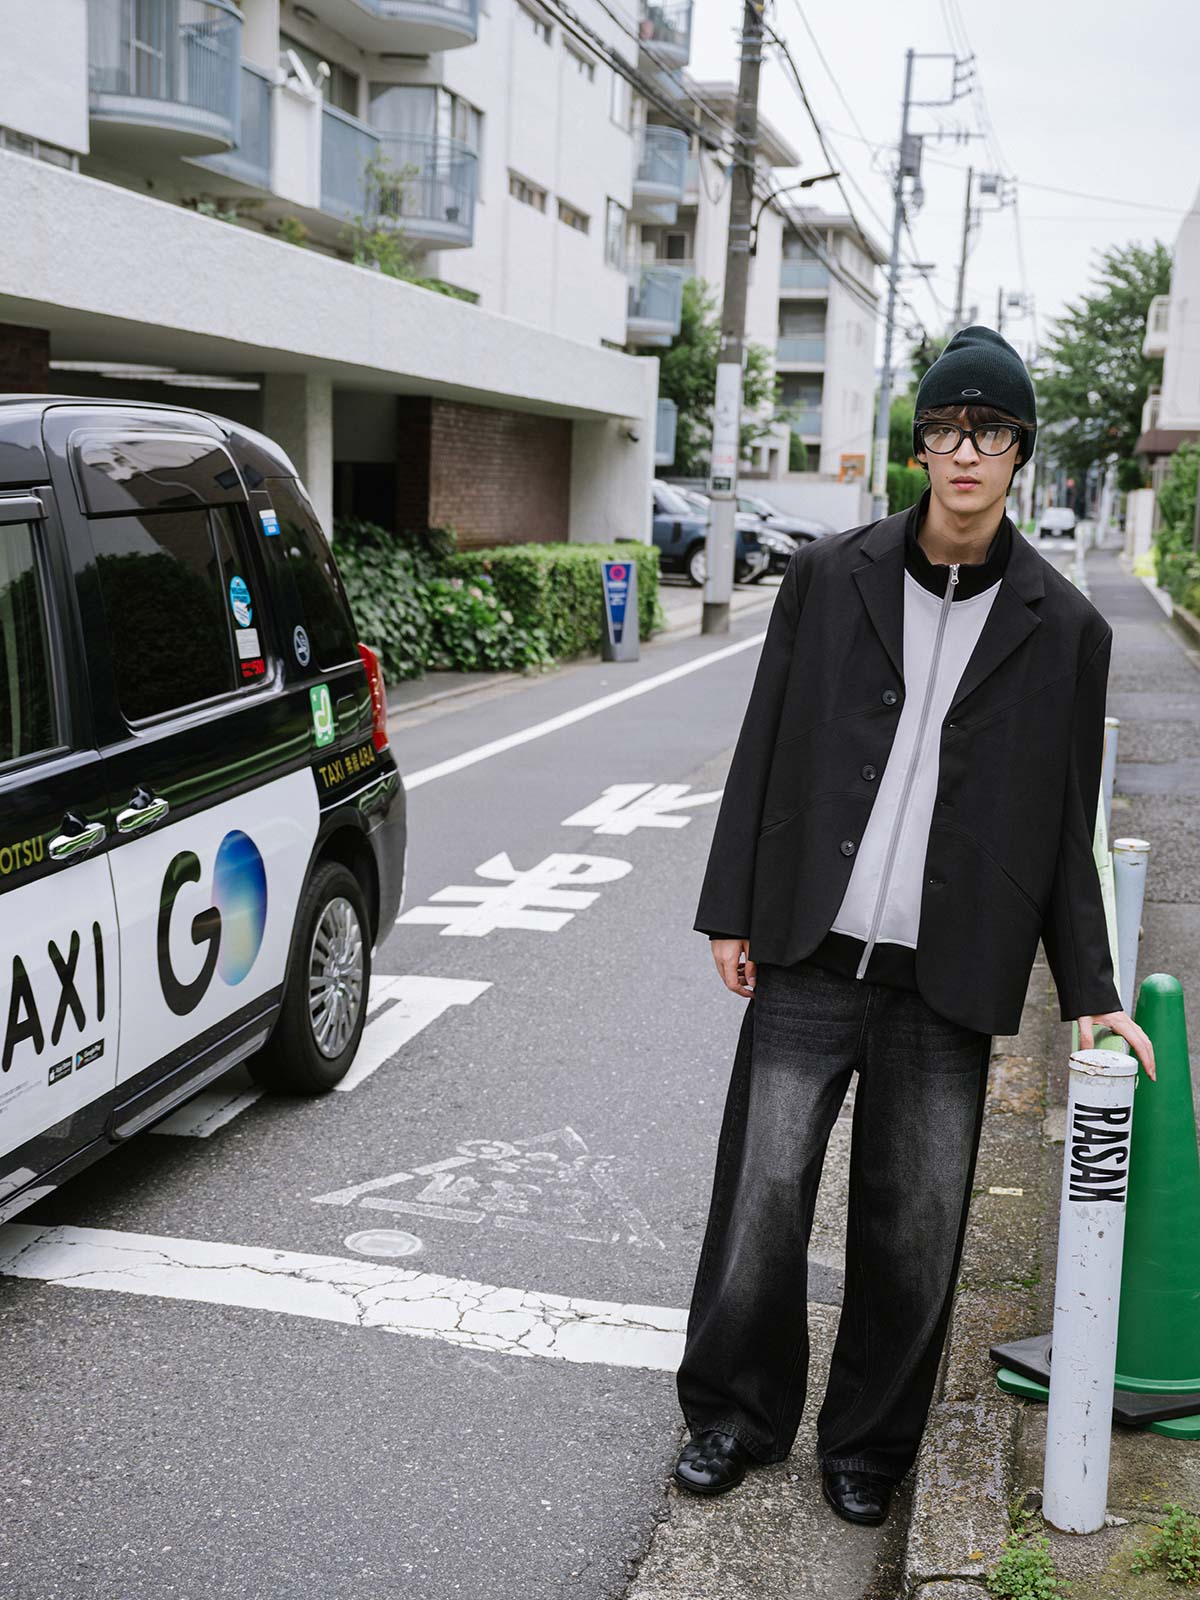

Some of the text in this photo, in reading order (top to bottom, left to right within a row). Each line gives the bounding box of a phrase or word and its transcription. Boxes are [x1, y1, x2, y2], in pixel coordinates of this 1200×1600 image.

[318, 759, 346, 788] TAXI
[0, 835, 44, 875] OTSU
[2, 829, 268, 1072] AXI GO
[1069, 1102, 1131, 1202] RASAK
